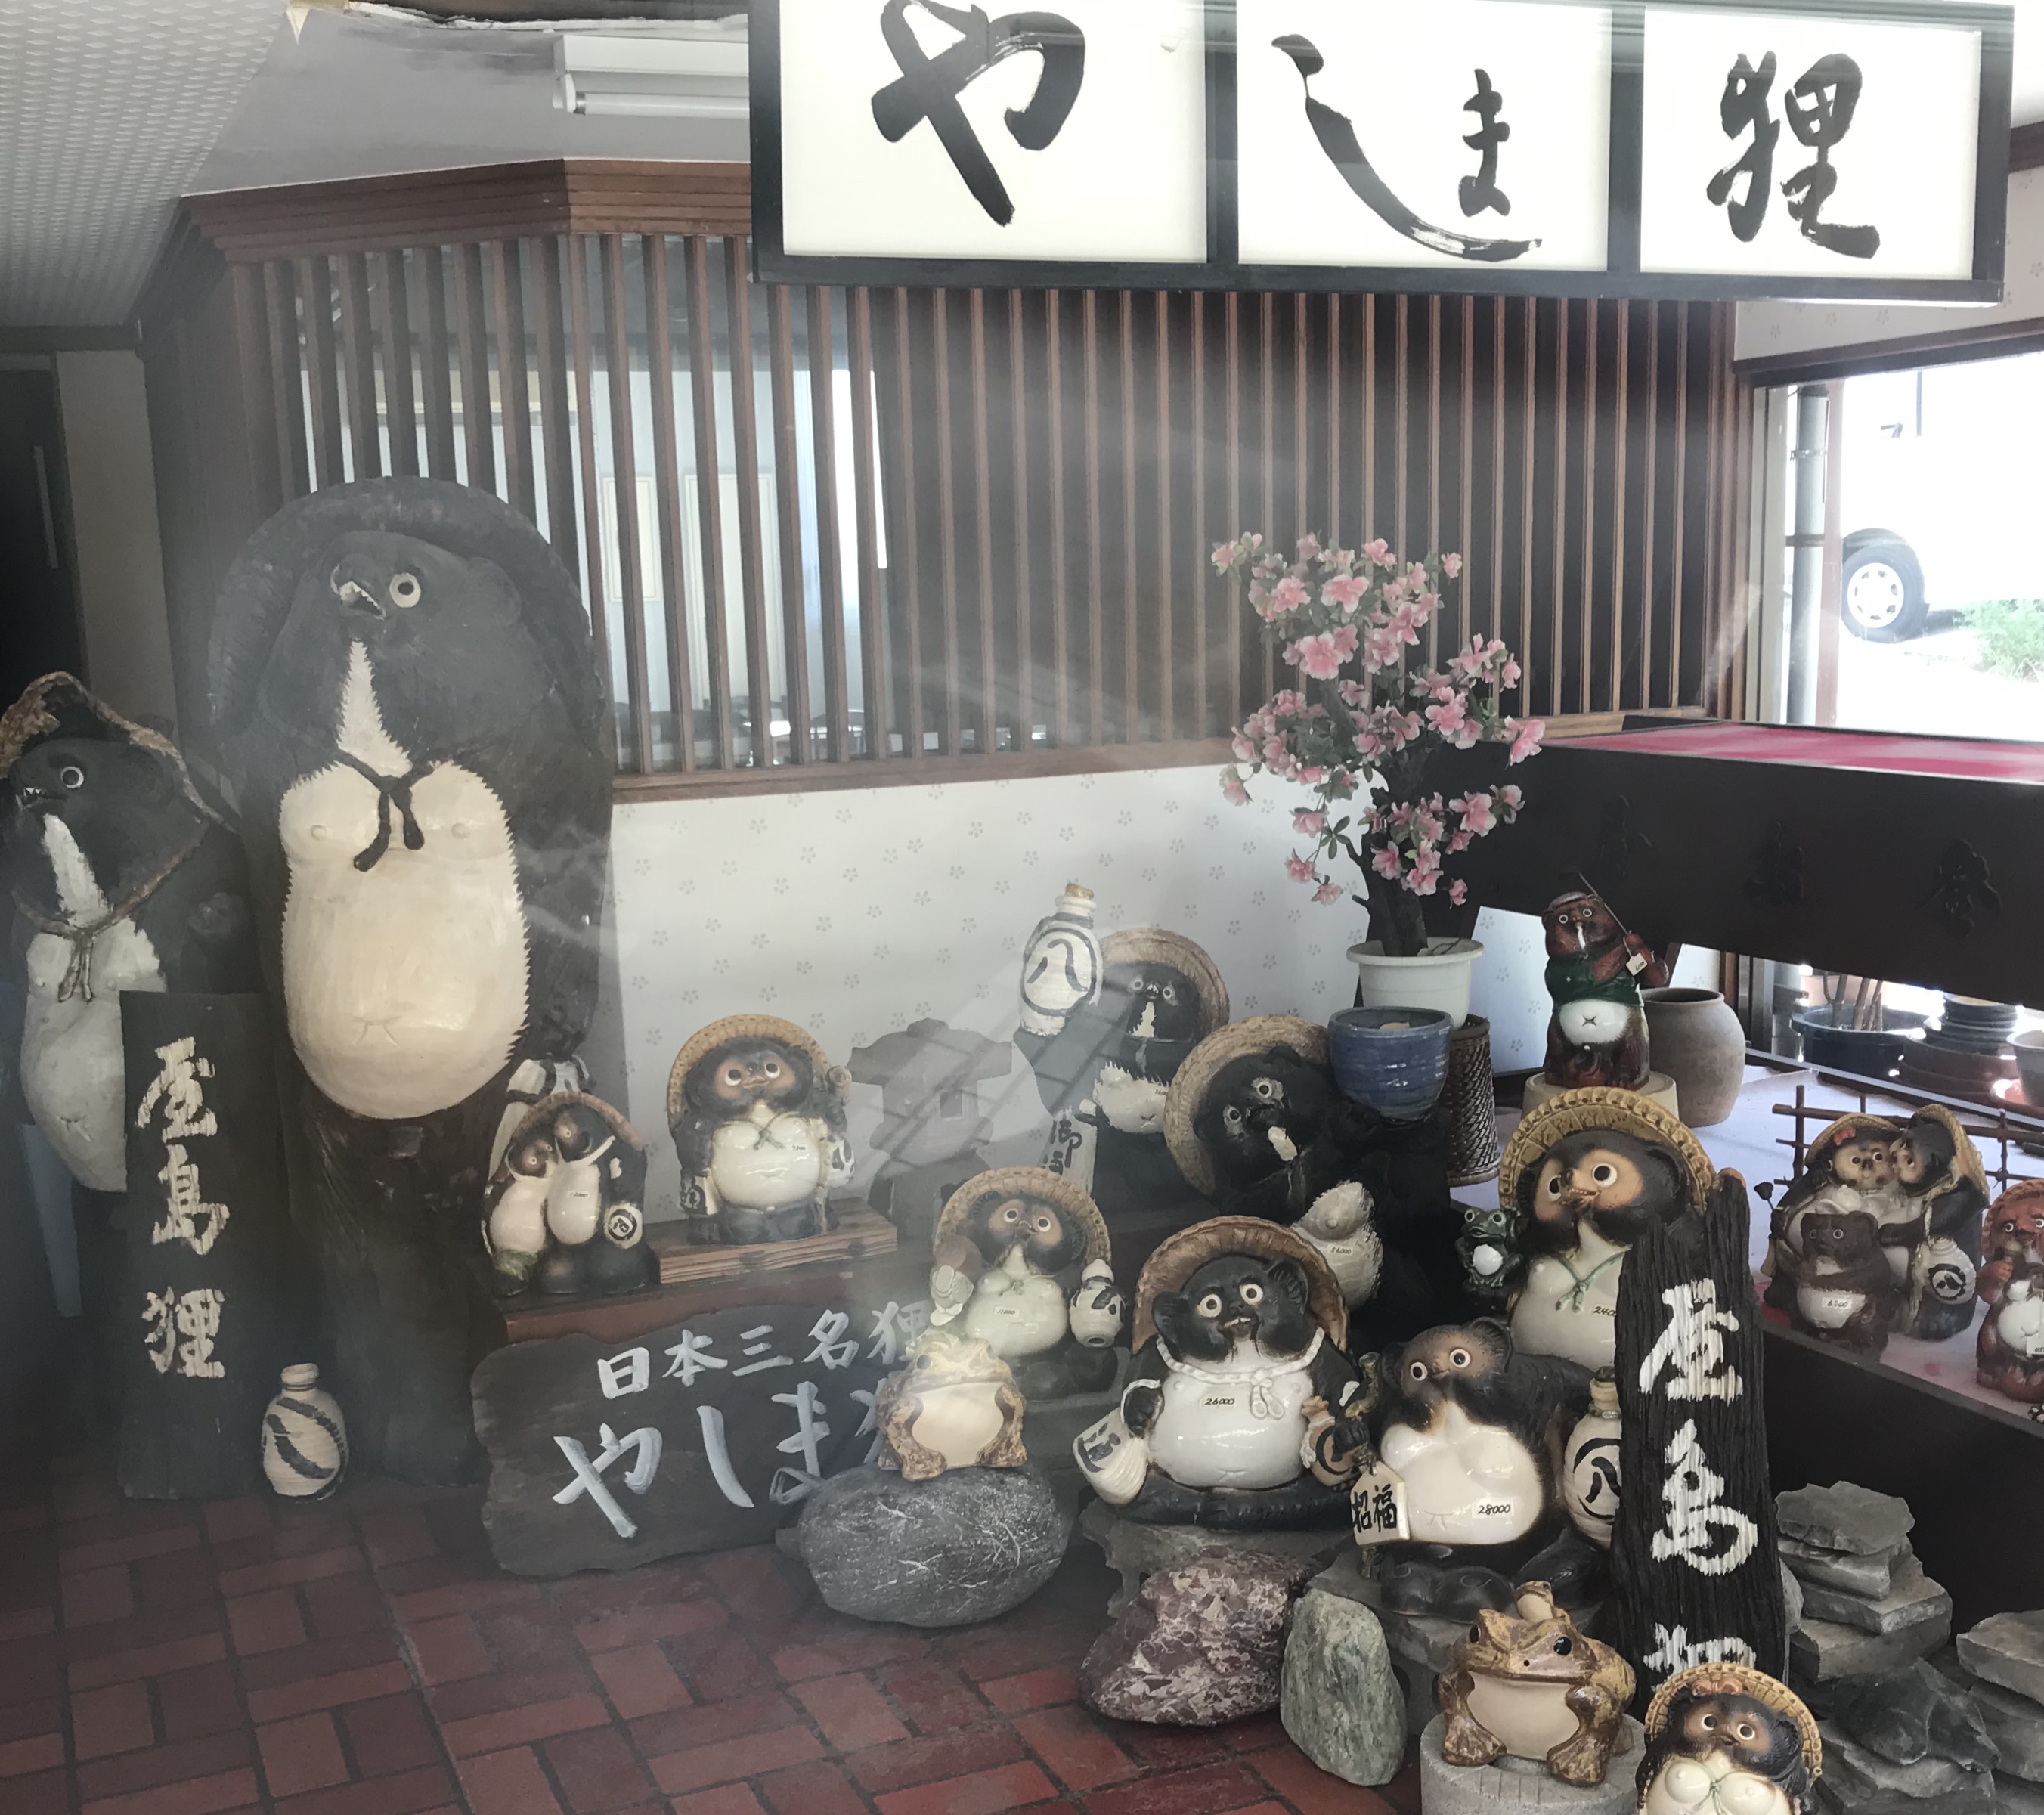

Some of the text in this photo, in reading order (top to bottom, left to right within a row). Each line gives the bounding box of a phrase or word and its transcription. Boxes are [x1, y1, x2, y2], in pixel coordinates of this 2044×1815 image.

[871, 0, 1881, 259] やしま狸
[1204, 1398, 1235, 1406] 26000
[1352, 1483, 1398, 1533] 招福
[1477, 1504, 1511, 1516] 28000
